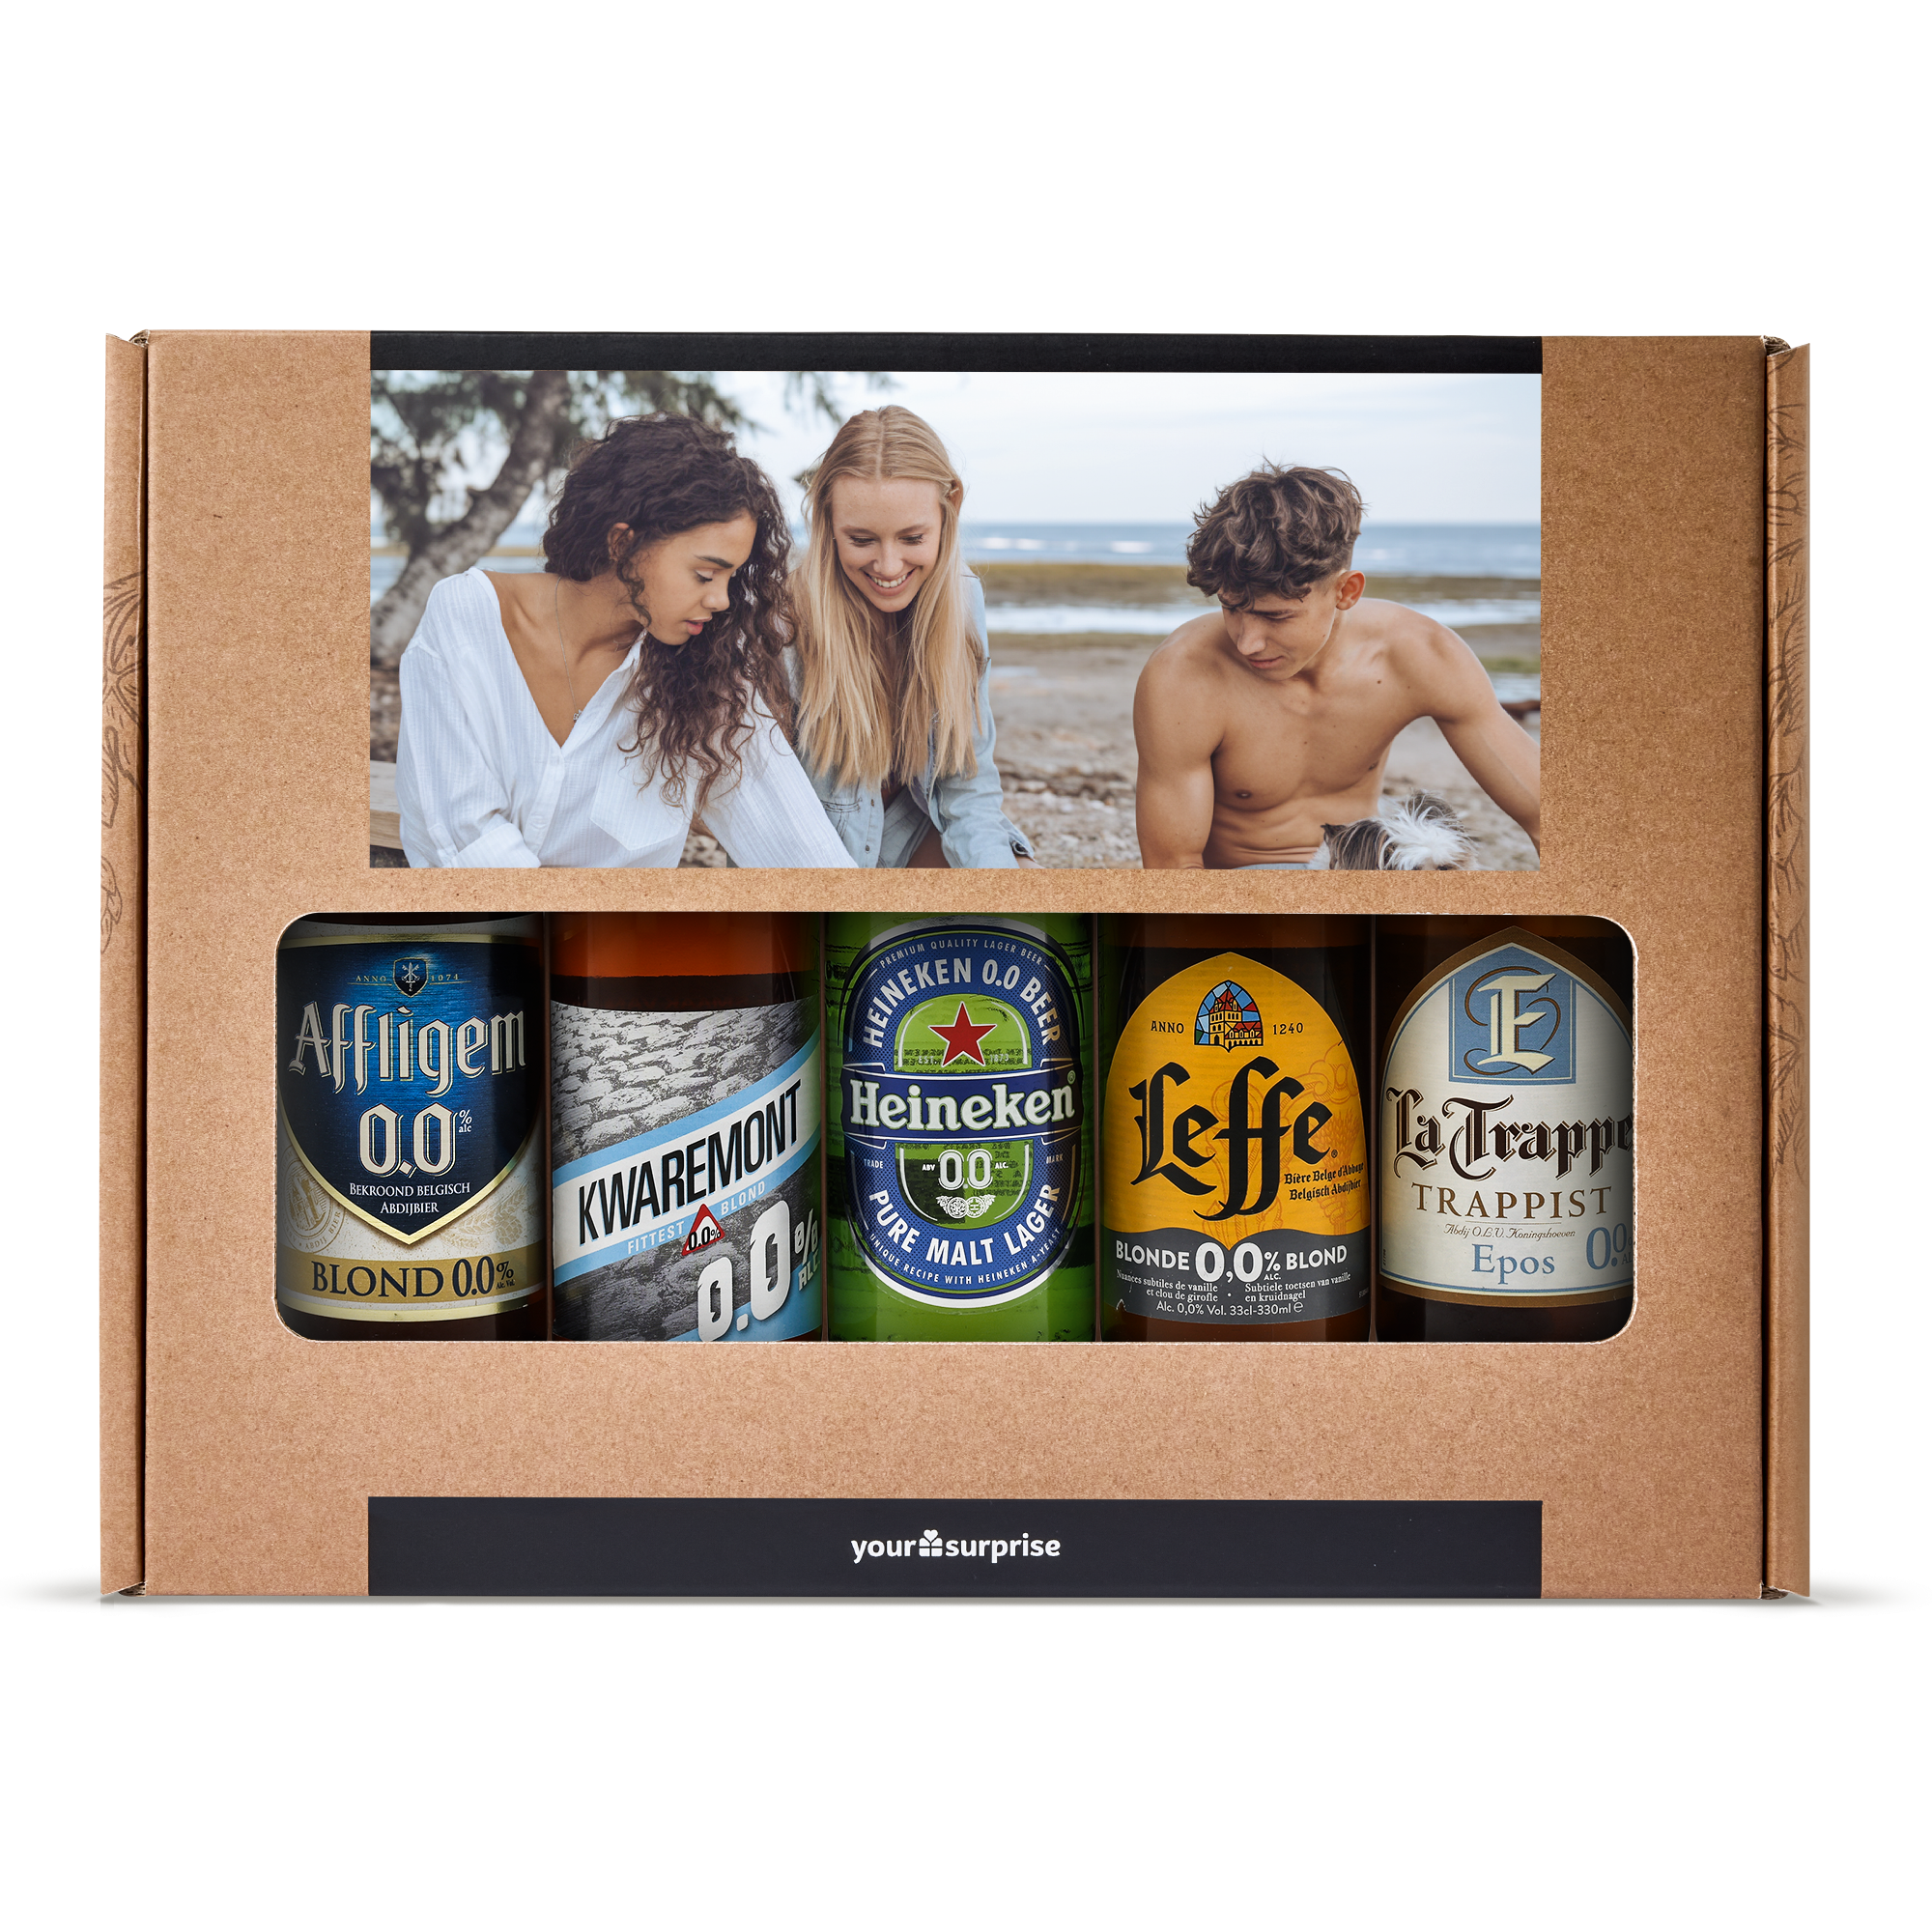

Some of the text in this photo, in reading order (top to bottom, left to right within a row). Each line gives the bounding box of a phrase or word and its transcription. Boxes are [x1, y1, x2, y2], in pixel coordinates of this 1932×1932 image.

[880, 939, 1042, 969] PREMIUM QUALITY LAGER BEER
[863, 957, 1061, 1048] HEINEKEN 0.0 BEER
[1151, 1020, 1304, 1036] ANNO 1240
[1476, 973, 1556, 1074] E
[288, 1001, 526, 1095] Affligem
[918, 1055, 938, 1065] EST.
[989, 1053, 1009, 1063] 1873
[459, 1123, 472, 1133] alc
[1128, 1056, 1333, 1221] Leffe
[1385, 1087, 1633, 1181] La Trappe
[579, 1079, 802, 1245] KWAREMONT
[864, 1153, 1064, 1169] TRADE MARK
[350, 1181, 471, 1198] BEKROOND BELGISCH
[1284, 1172, 1312, 1184] Bière
[1312, 1168, 1336, 1181] Belge
[1290, 1185, 1330, 1201] Belgisch
[1411, 1181, 1612, 1220] TRAPPIST
[380, 1202, 440, 1217] ABDIJBIER
[627, 1180, 766, 1255] FITTEST BLOND
[868, 1183, 1061, 1266] PURE MALT LAGER
[1443, 1223, 1470, 1239] Abdij
[1506, 1227, 1577, 1242] Koningshoeven
[688, 1226, 722, 1251] 0.0%
[869, 1228, 1061, 1285] UNIQUE RECIPE WITH HEINEKEN A-YEAST
[1116, 1239, 1190, 1270] BLONDE
[1286, 1244, 1348, 1270] BLOND
[1471, 1243, 1555, 1285] Epos
[311, 1261, 444, 1297] BLOND
[1117, 1268, 1218, 1293] Nuances subtiles de vanille
[1244, 1271, 1350, 1293] Subtiele toetsen van vanille
[1146, 1288, 1218, 1303] et clou de girofle
[1156, 1300, 1175, 1313] Alc.
[1177, 1302, 1205, 1316] 0,0%
[1207, 1304, 1227, 1316] Vol.
[1230, 1303, 1292, 1316] 33cl-330ml
[1259, 1290, 1306, 1303] kruidnagel
[851, 1532, 1062, 1564] your surprise
